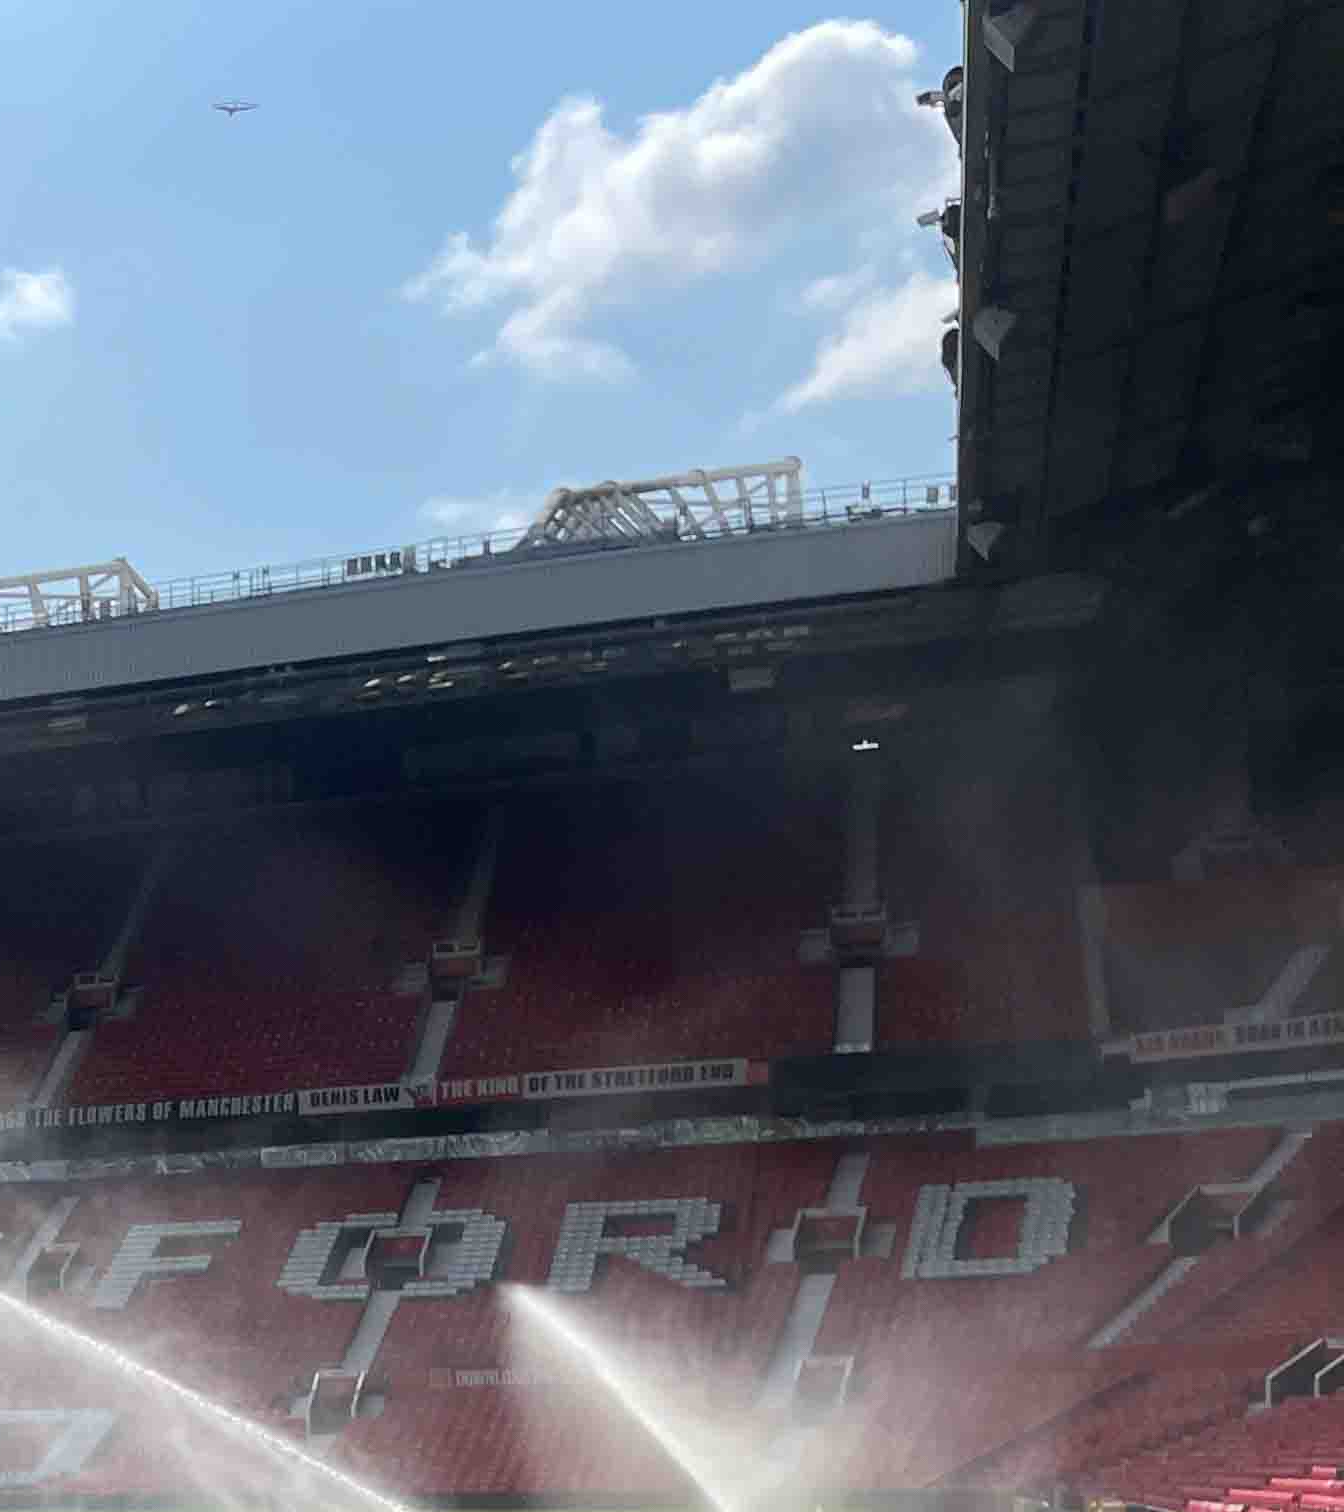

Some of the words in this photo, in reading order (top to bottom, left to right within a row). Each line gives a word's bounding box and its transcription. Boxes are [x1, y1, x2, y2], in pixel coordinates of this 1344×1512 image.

[310, 1088, 359, 1108] DENIS
[363, 1085, 401, 1104] LAW
[440, 1079, 476, 1100] THE
[478, 1077, 519, 1098] KING
[529, 1075, 548, 1093] OF
[549, 1072, 585, 1090] THE
[34, 1104, 63, 1128] THE
[68, 1101, 146, 1127] FLOWERS
[151, 1099, 173, 1120] OF
[179, 1093, 295, 1120] MANCHESTER
